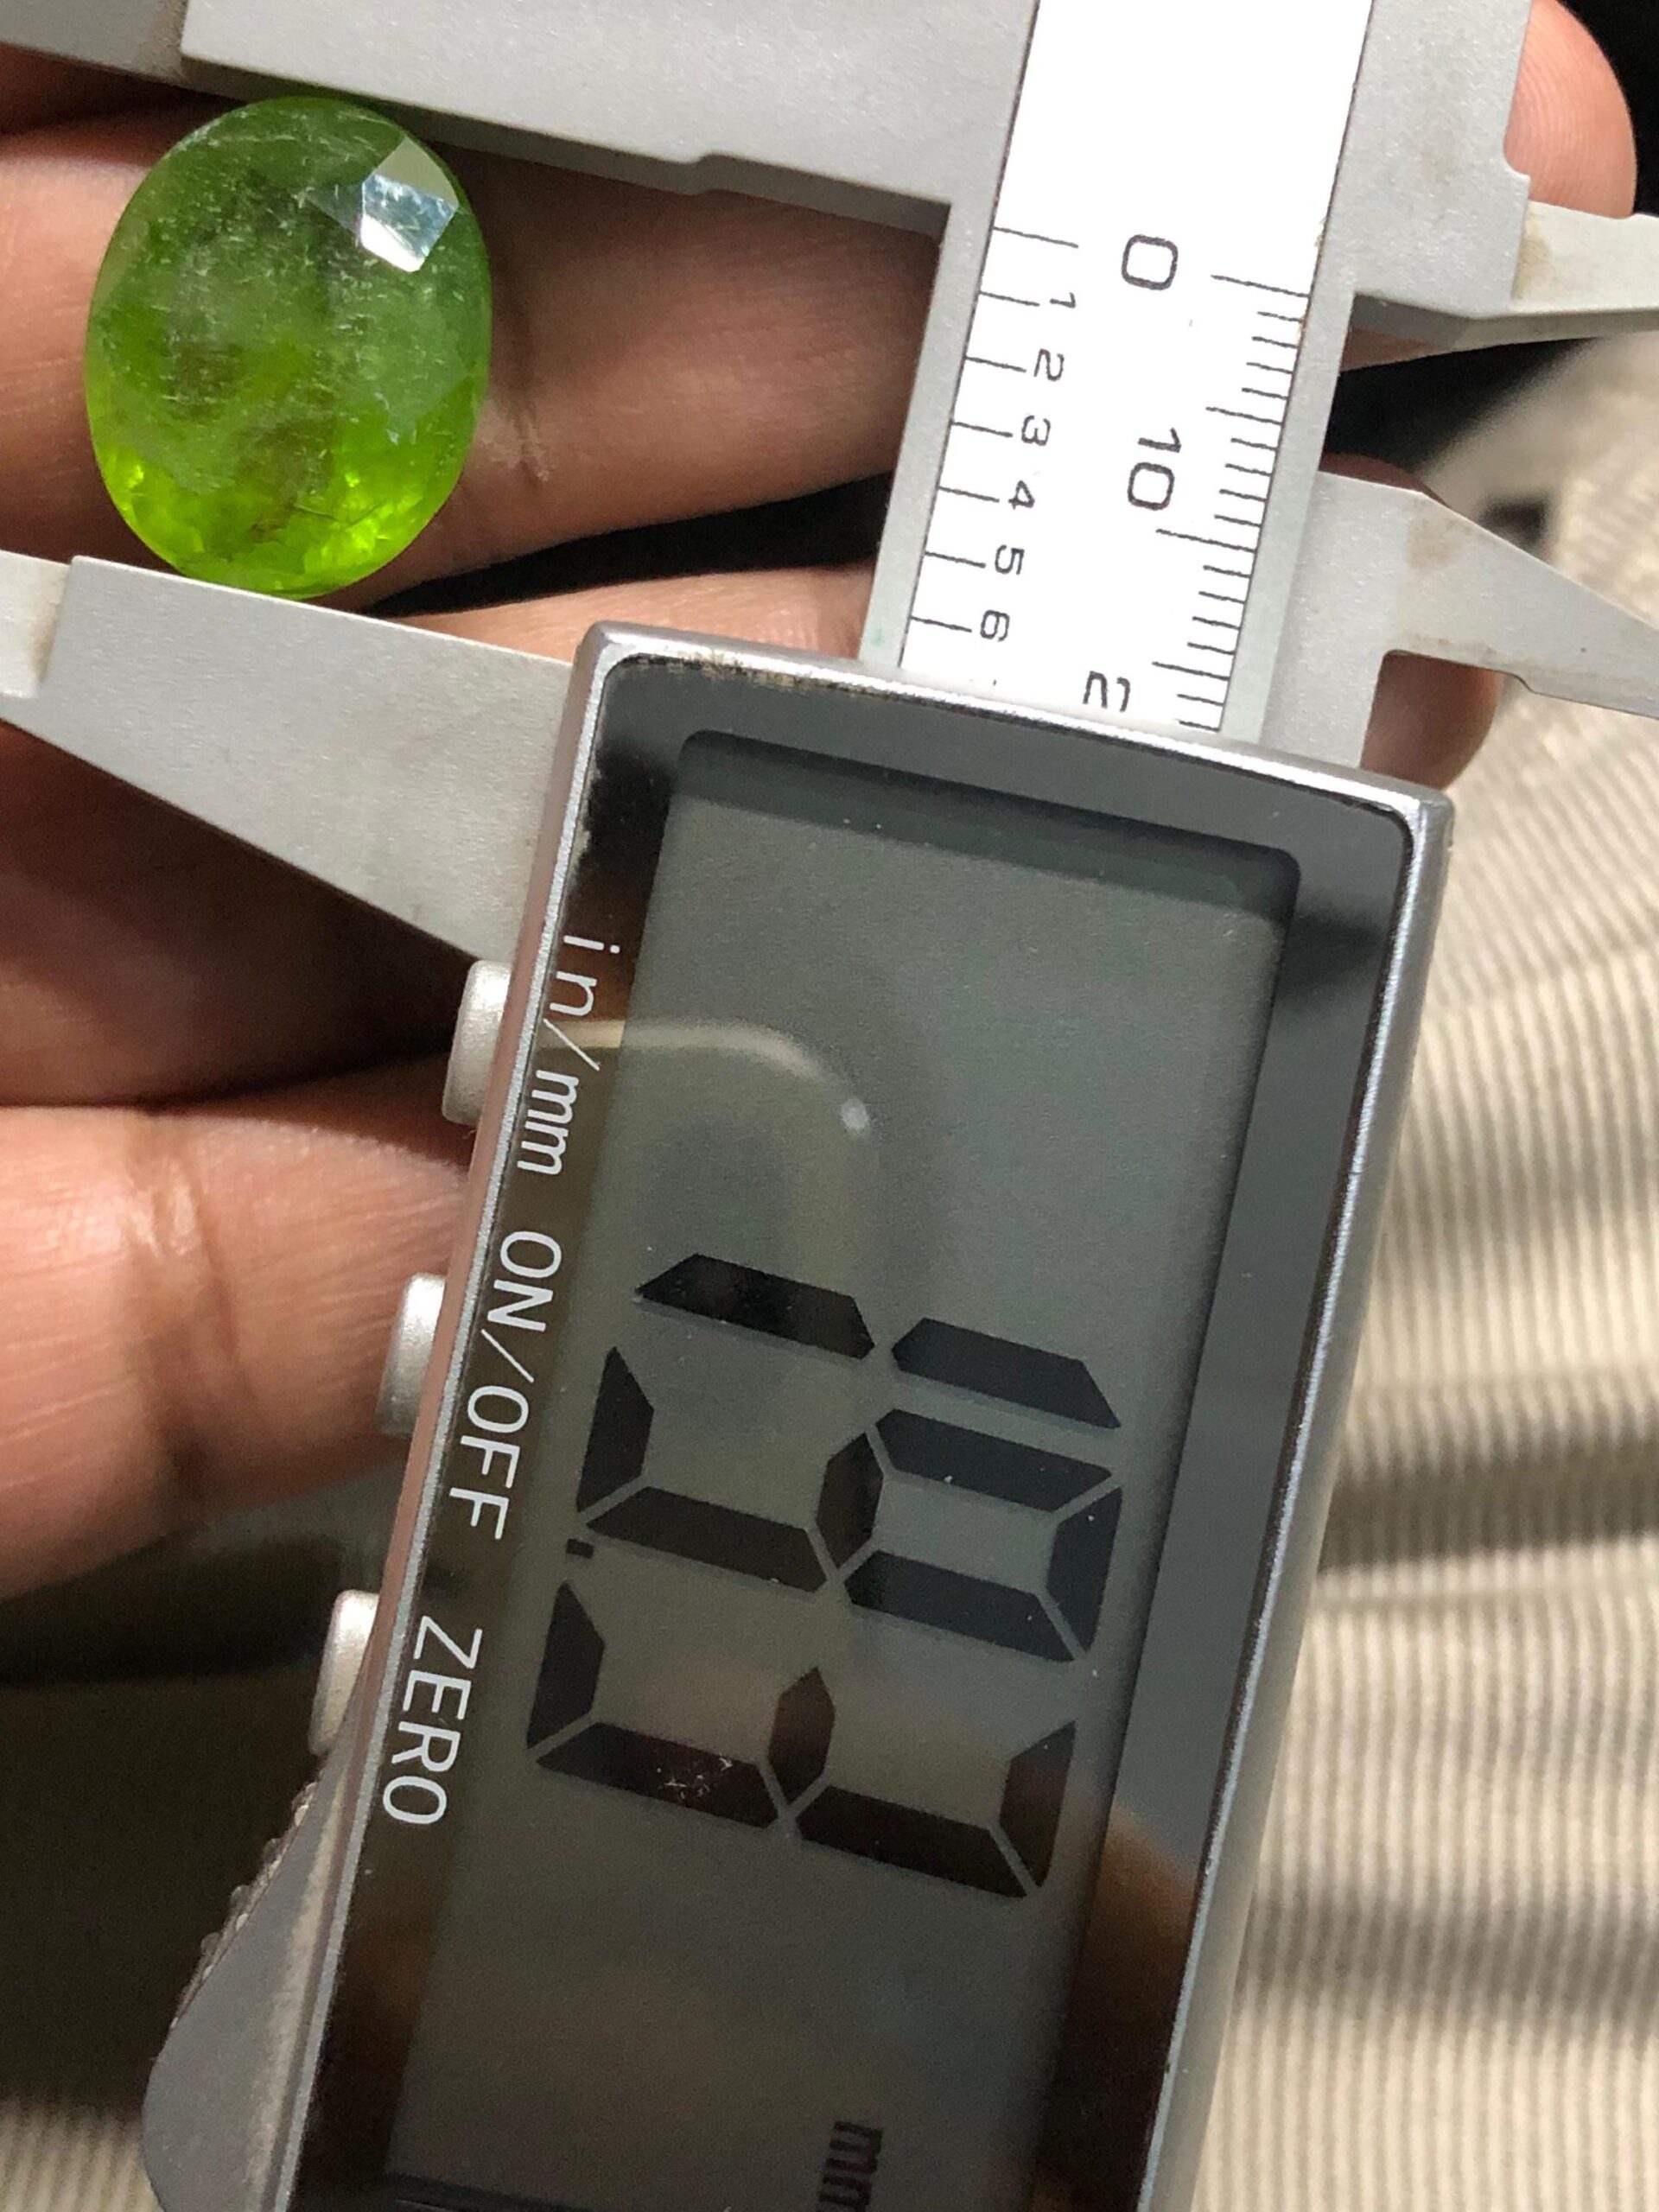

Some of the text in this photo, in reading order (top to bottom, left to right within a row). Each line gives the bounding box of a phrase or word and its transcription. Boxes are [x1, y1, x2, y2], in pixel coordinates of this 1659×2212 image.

[1122, 233, 1179, 290] 0
[980, 292, 1077, 642] 1 2 3 4 5 6
[1127, 428, 1181, 511] 10
[382, 935, 620, 1825] in/mm ON/OFF ZERO
[525, 1253, 1123, 1900] 19.3
